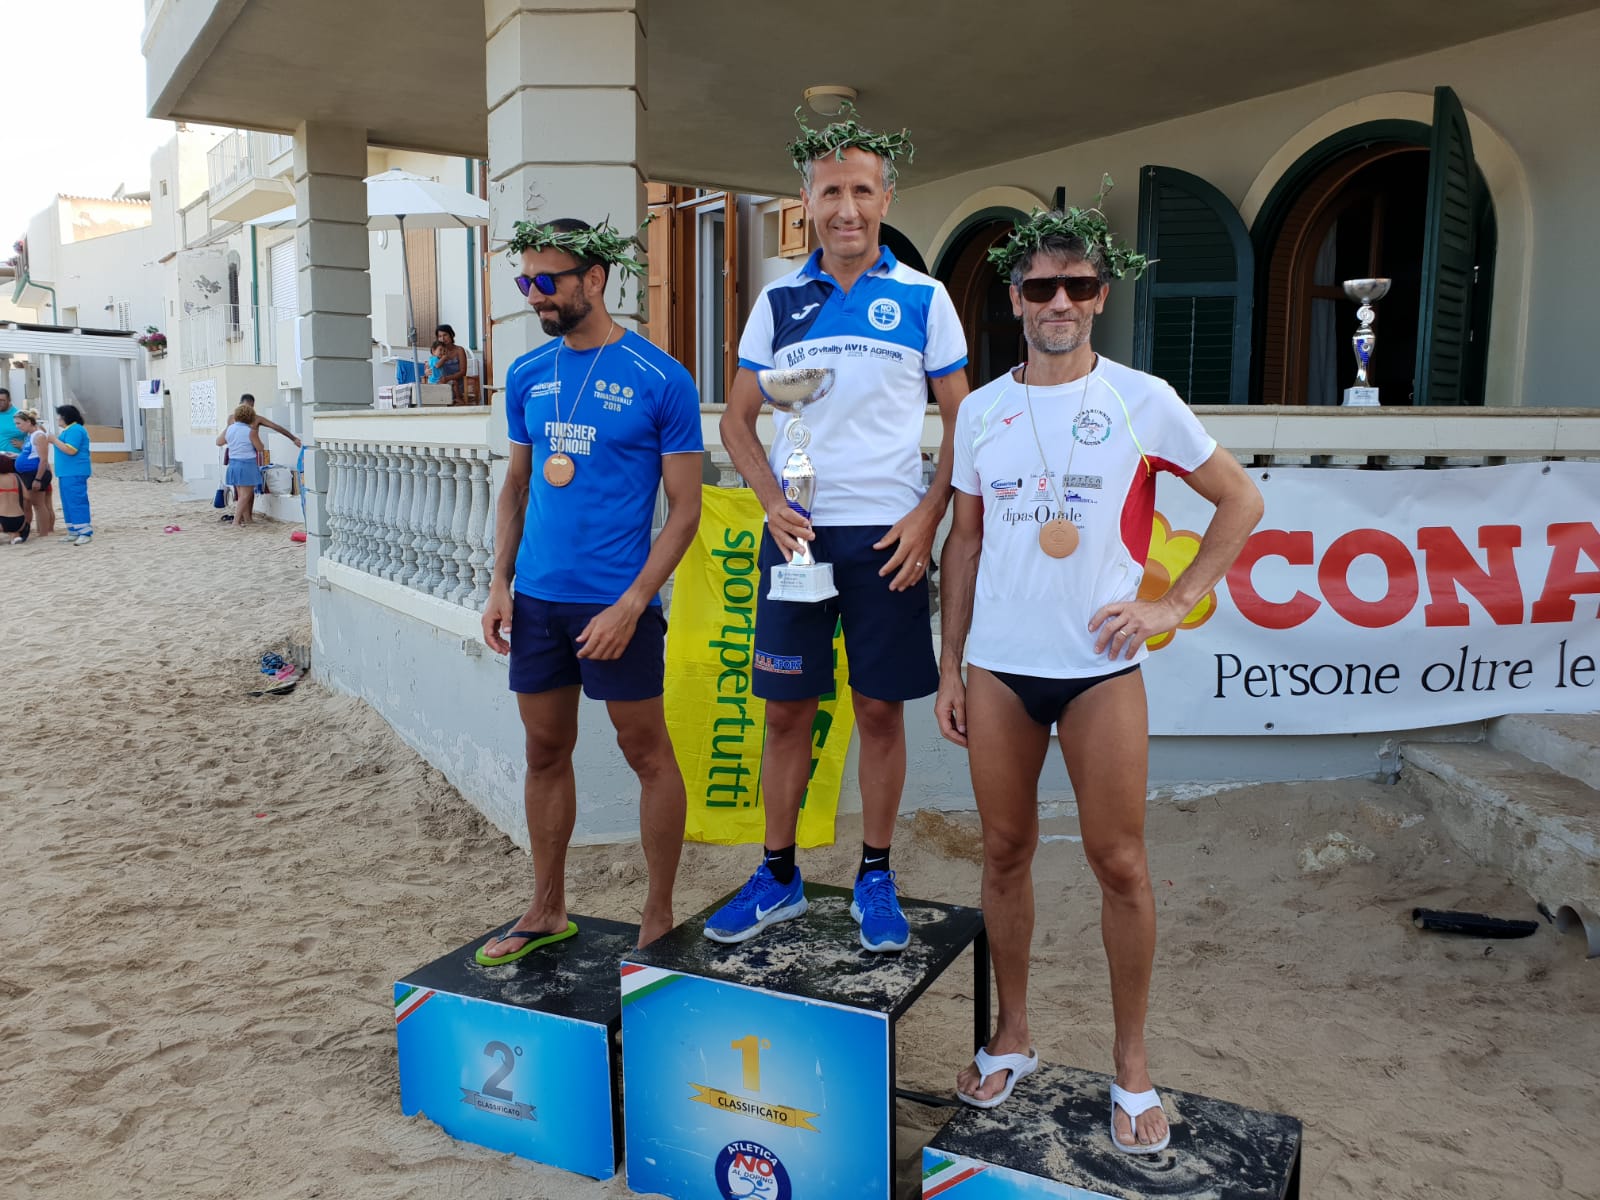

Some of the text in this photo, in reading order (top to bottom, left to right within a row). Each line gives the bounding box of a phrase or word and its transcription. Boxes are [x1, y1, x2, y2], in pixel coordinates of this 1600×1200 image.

[544, 421, 597, 442] FINISHER
[706, 527, 757, 809] sportpertutti
[1213, 639, 1596, 699] Persone oltre le
[477, 1100, 521, 1117] CLASSIFICATO
[717, 1096, 788, 1122] CLASSIFICATO
[727, 1142, 778, 1167] ATLETICA
[733, 1152, 773, 1177] NO
[731, 1168, 774, 1185] AL DOPING
